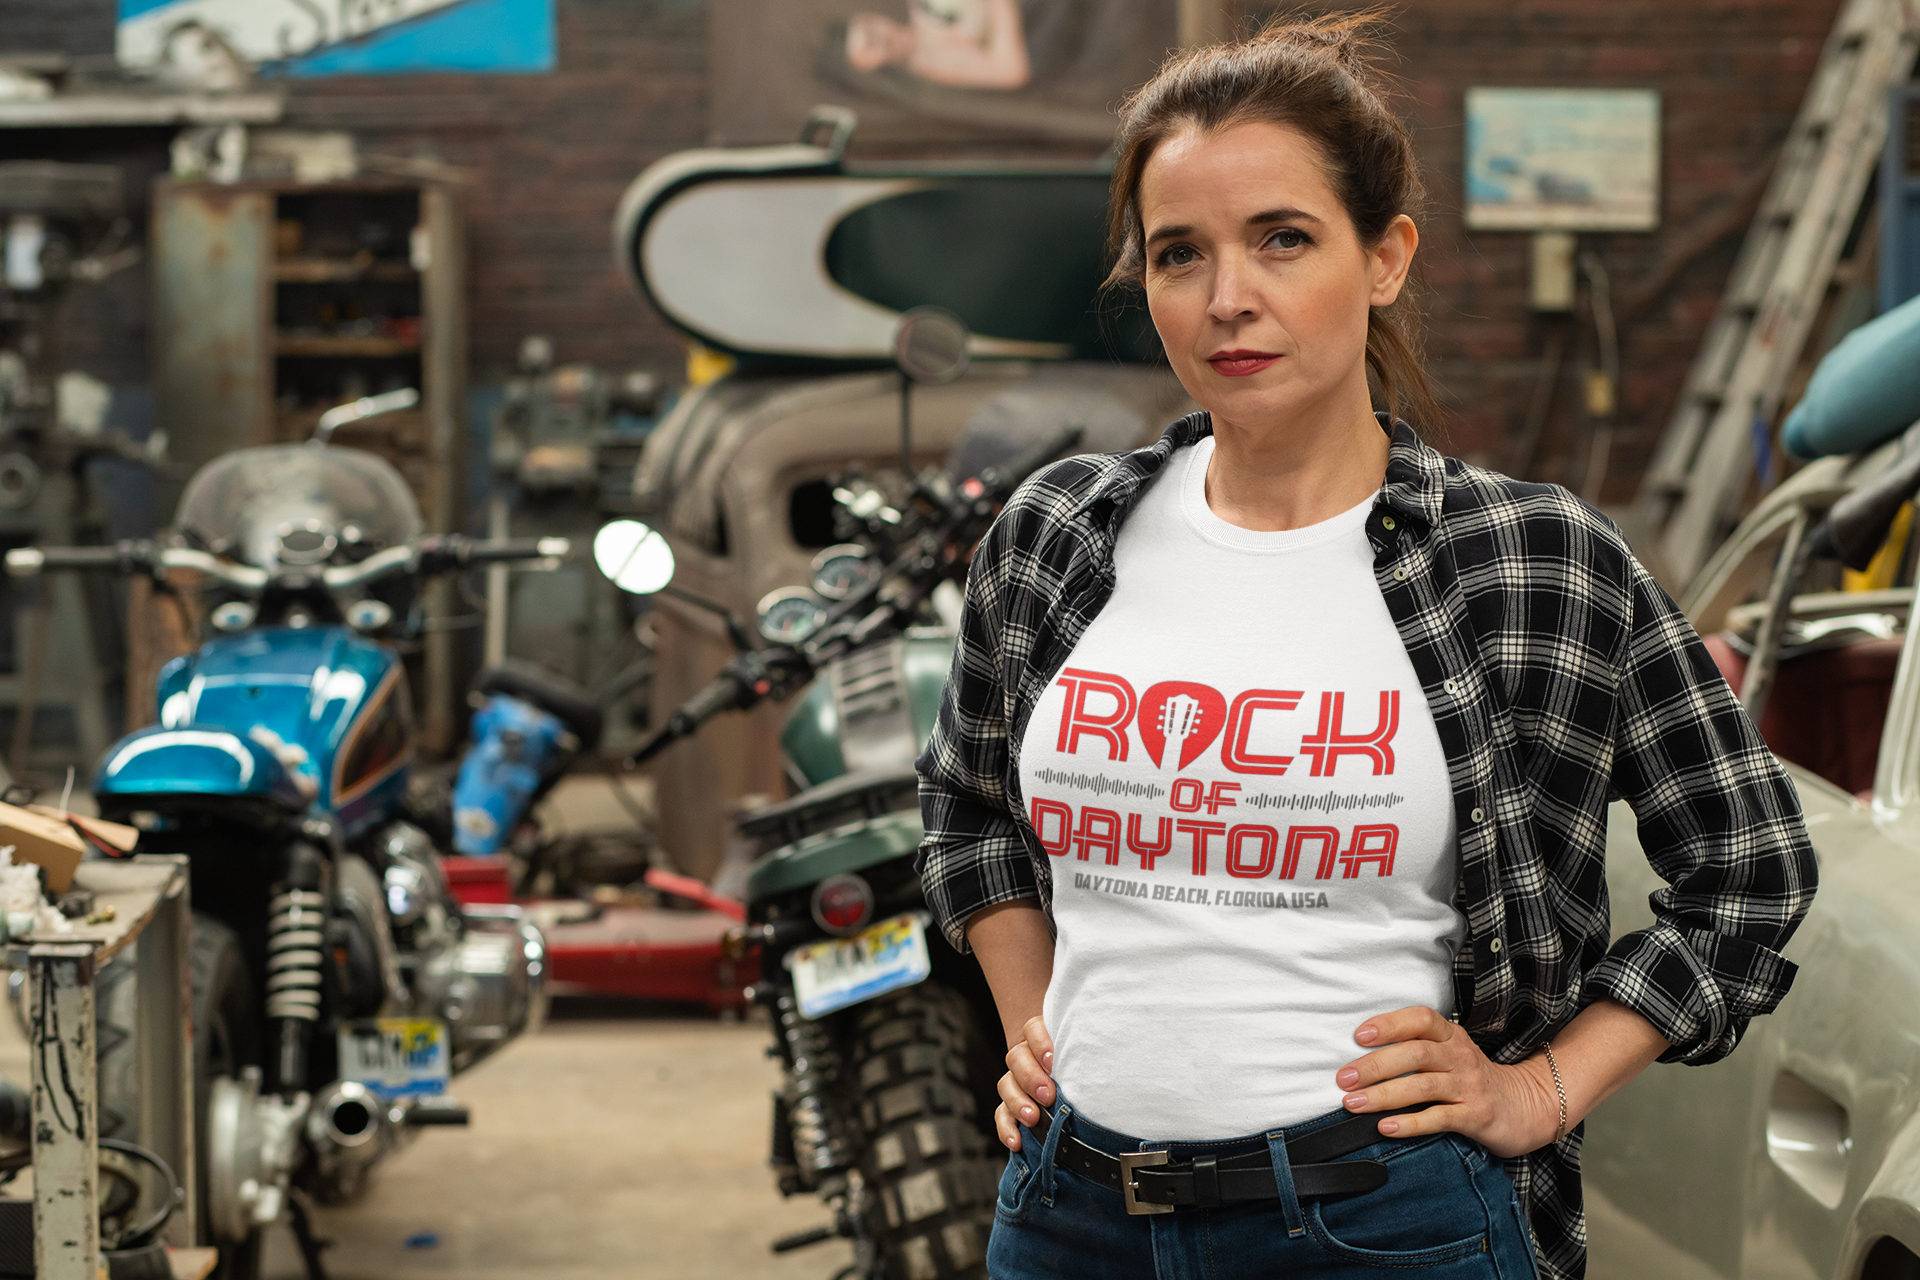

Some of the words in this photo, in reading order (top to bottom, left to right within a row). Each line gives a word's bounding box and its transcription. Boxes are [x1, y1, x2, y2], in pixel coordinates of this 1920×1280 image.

[1169, 778, 1242, 815] OF
[1031, 797, 1399, 880] DAYTONA
[1075, 873, 1148, 899] DAYTONA
[1152, 884, 1211, 906] BEACH,
[1214, 889, 1288, 909] FLORIDA
[1291, 892, 1329, 909] USA
